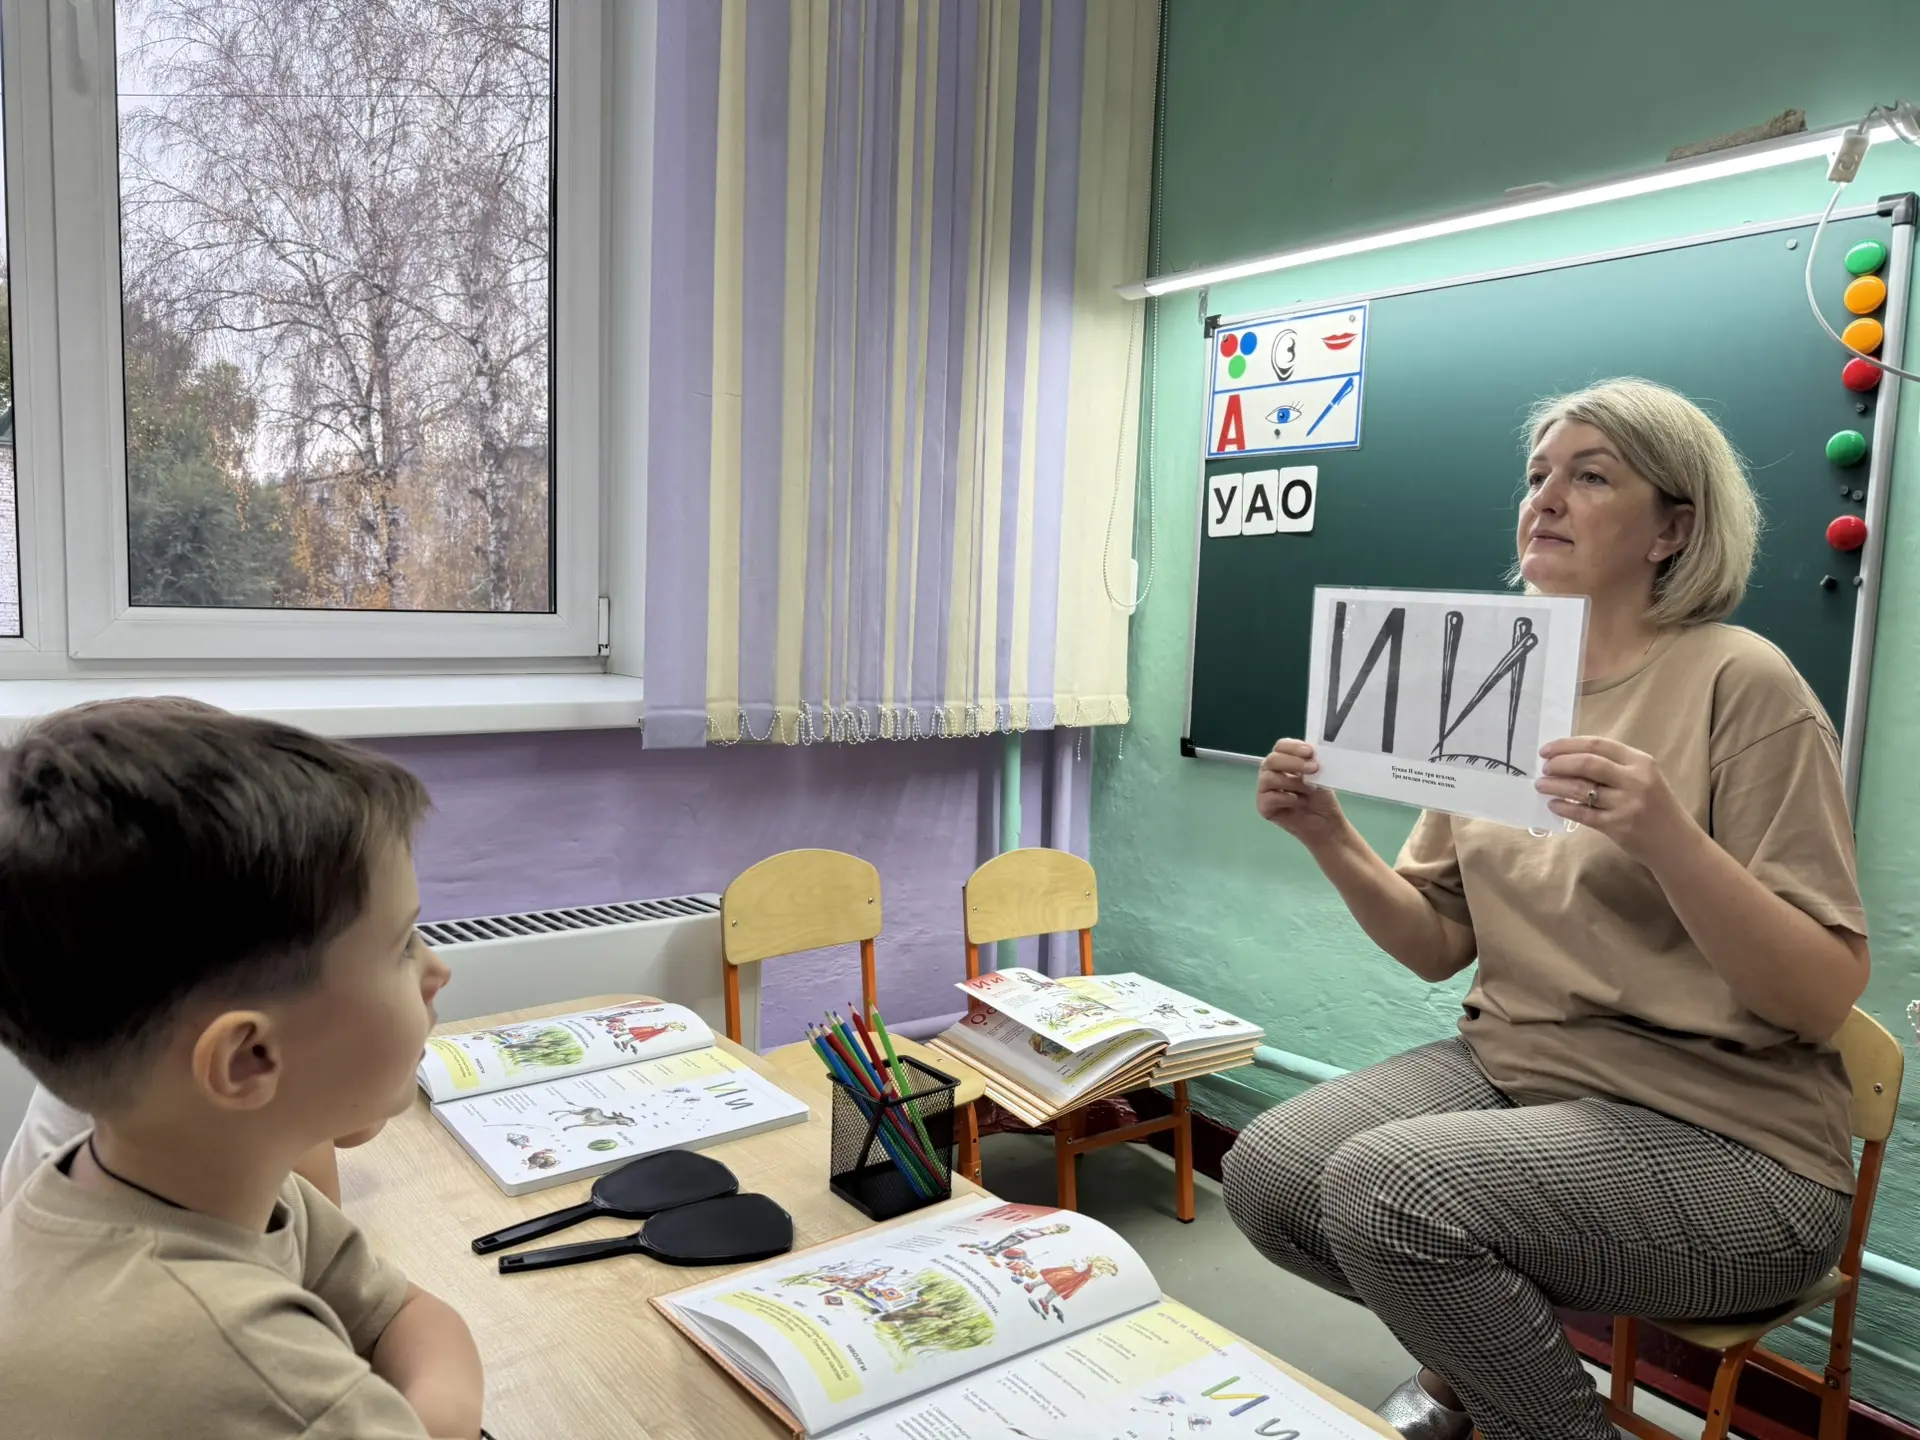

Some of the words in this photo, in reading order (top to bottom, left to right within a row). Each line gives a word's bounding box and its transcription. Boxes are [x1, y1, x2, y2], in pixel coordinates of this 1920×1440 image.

[1216, 394, 1246, 452] А
[846, 1344, 867, 1372] иволги
[1201, 1375, 1271, 1418] И
